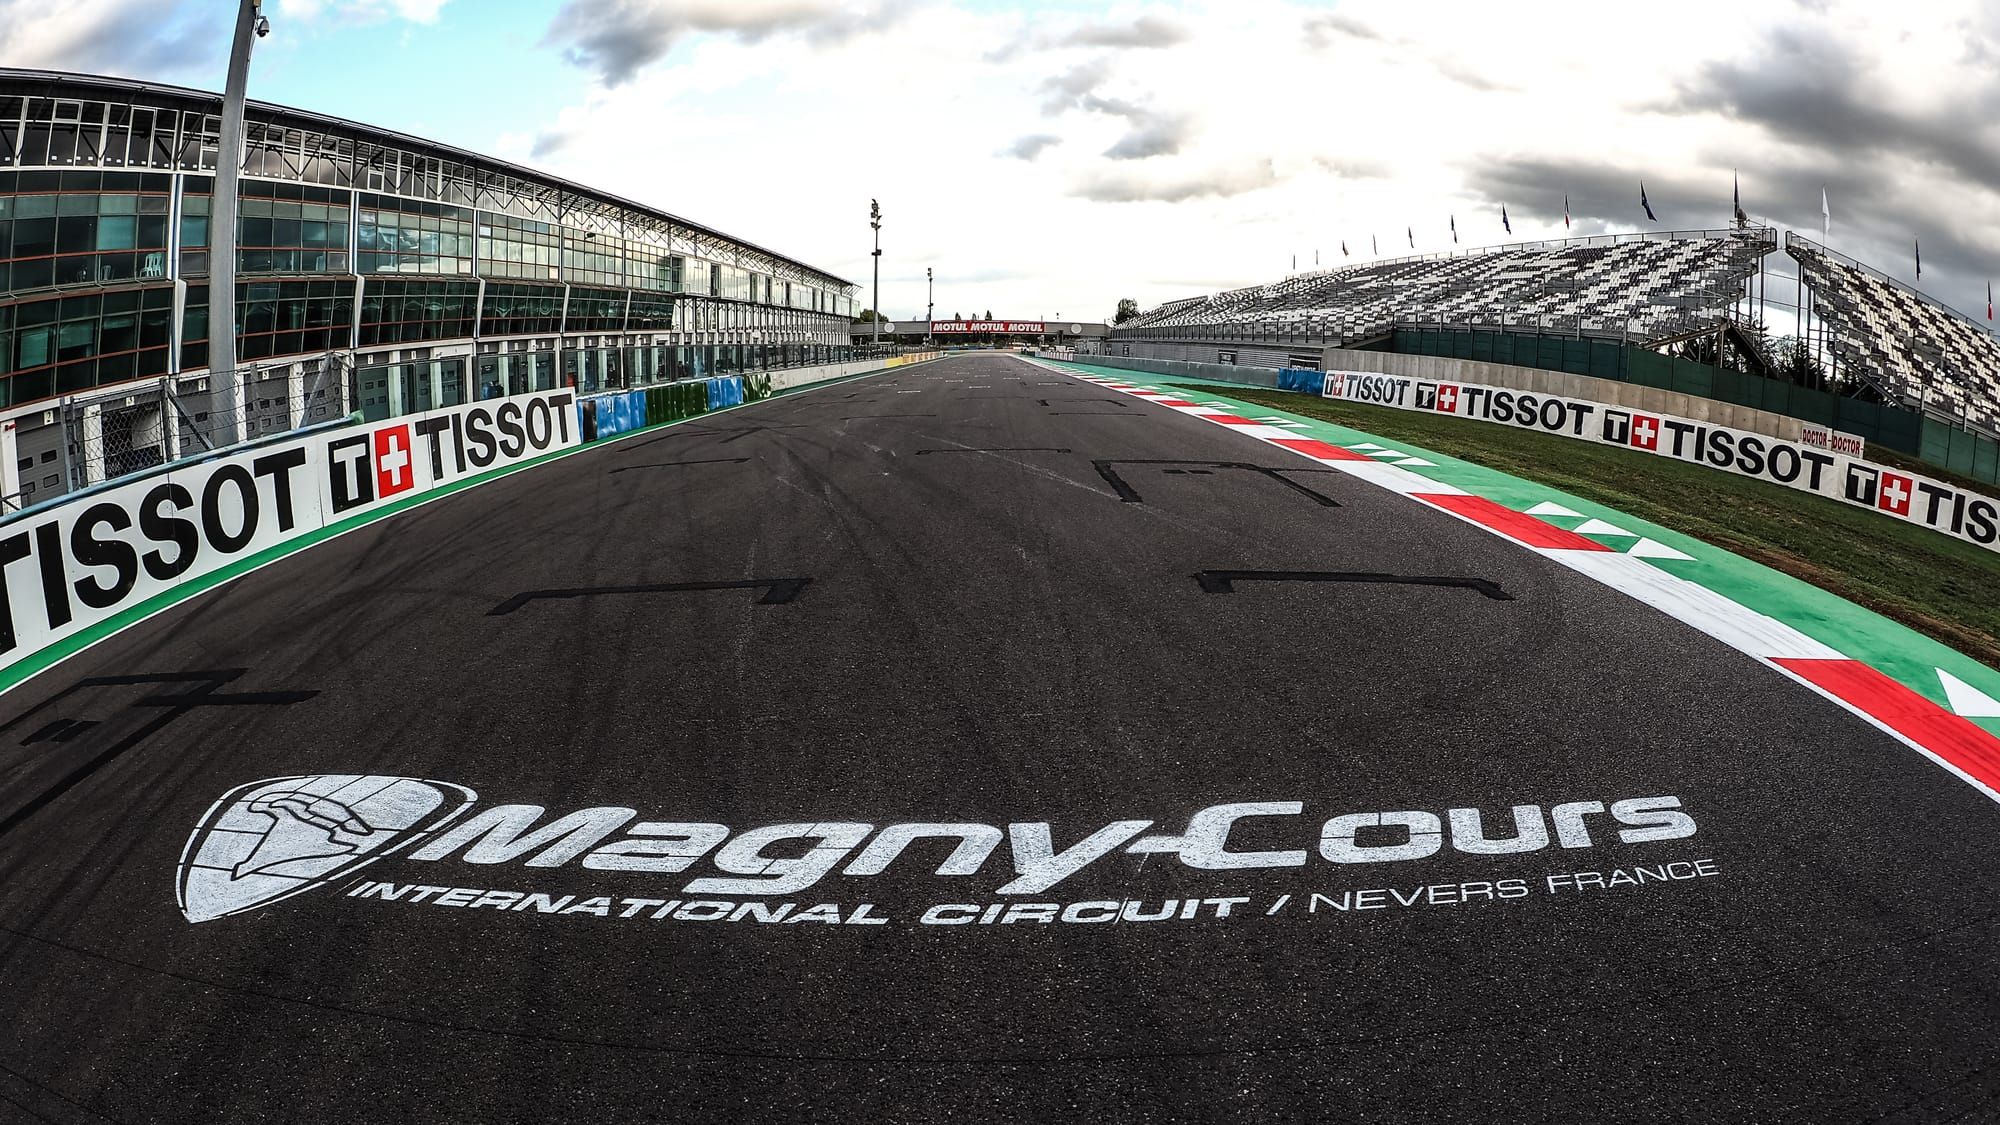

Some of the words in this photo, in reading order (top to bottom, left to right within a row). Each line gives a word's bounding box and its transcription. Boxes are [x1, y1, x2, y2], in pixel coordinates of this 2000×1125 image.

[933, 322, 968, 332] MOTUL
[970, 322, 1005, 332] MOTUL
[1008, 323, 1043, 332] MOTUL
[415, 393, 574, 482] TISSOT
[1346, 375, 1410, 406] TISSOT
[1462, 387, 1593, 435] TISSOT
[1664, 420, 1833, 490] TISSOT
[1918, 481, 2000, 544] TIS
[0, 446, 306, 655] TISSOT
[347, 881, 889, 926] INTERNATIONAL
[919, 896, 1250, 925] CIRCUIT
[1309, 878, 1529, 914] NEVERS
[1546, 858, 1720, 894] FRANCE
[408, 795, 1698, 896] Magny-Cours
